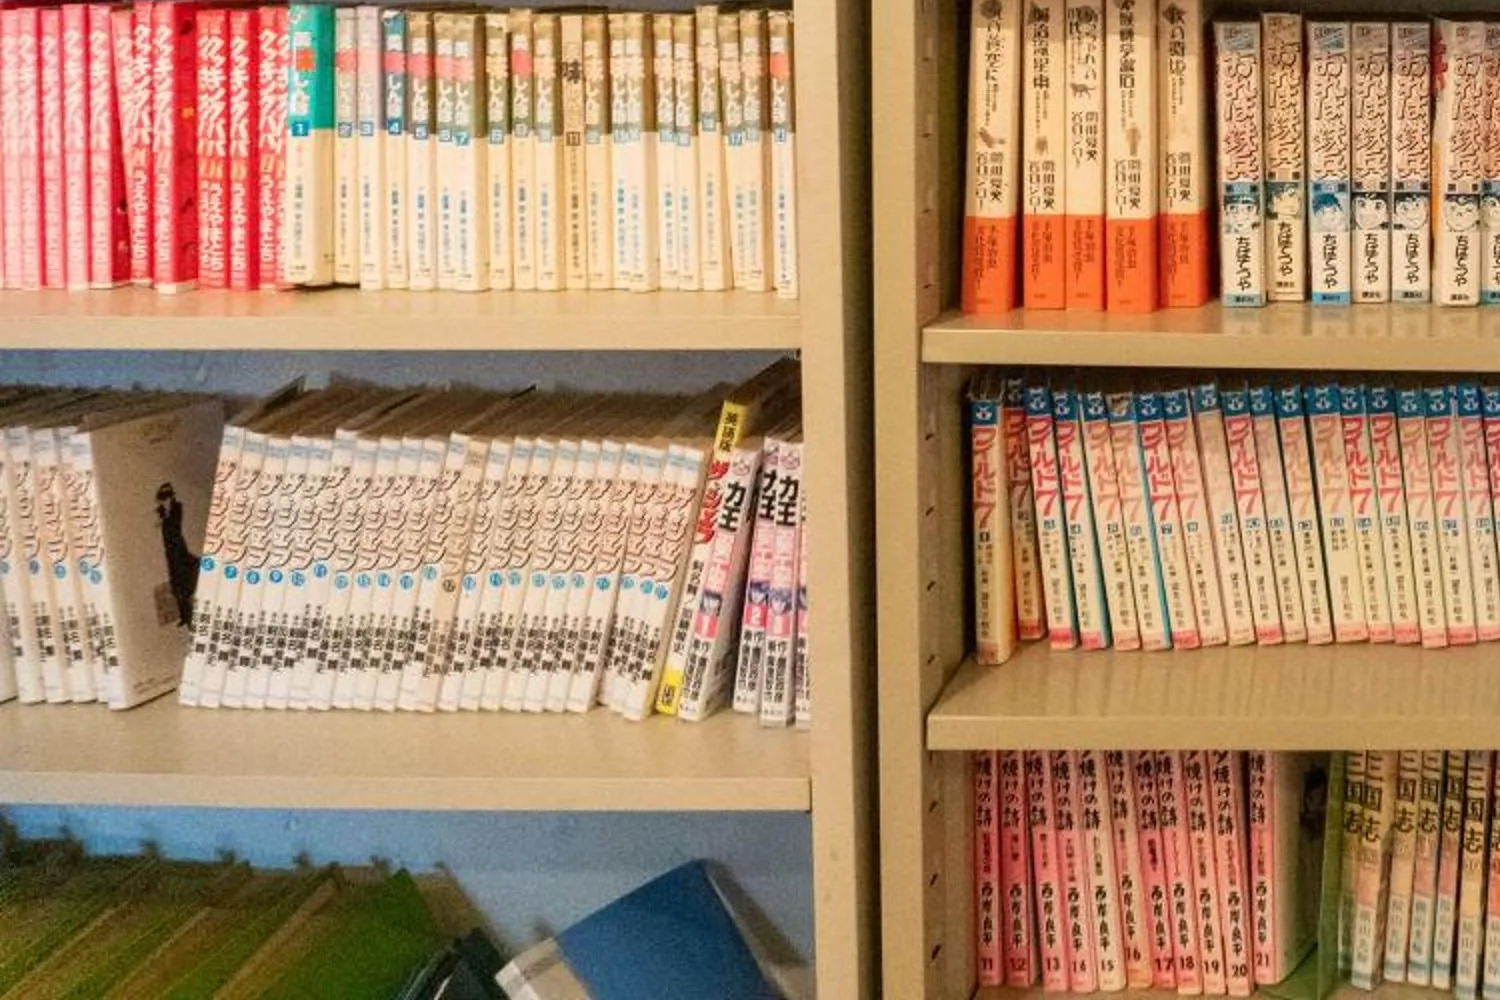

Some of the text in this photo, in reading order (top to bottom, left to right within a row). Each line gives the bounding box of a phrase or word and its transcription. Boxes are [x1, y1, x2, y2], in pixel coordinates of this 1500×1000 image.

[1236, 235, 1252, 291] ちばてつや
[717, 481, 746, 532] 力王
[776, 475, 799, 527] 力王
[1009, 957, 1026, 970] 12
[1100, 959, 1115, 972] 15
[1156, 957, 1173, 971] 17
[1203, 960, 1219, 973] 19
[1231, 964, 1247, 977] 20
